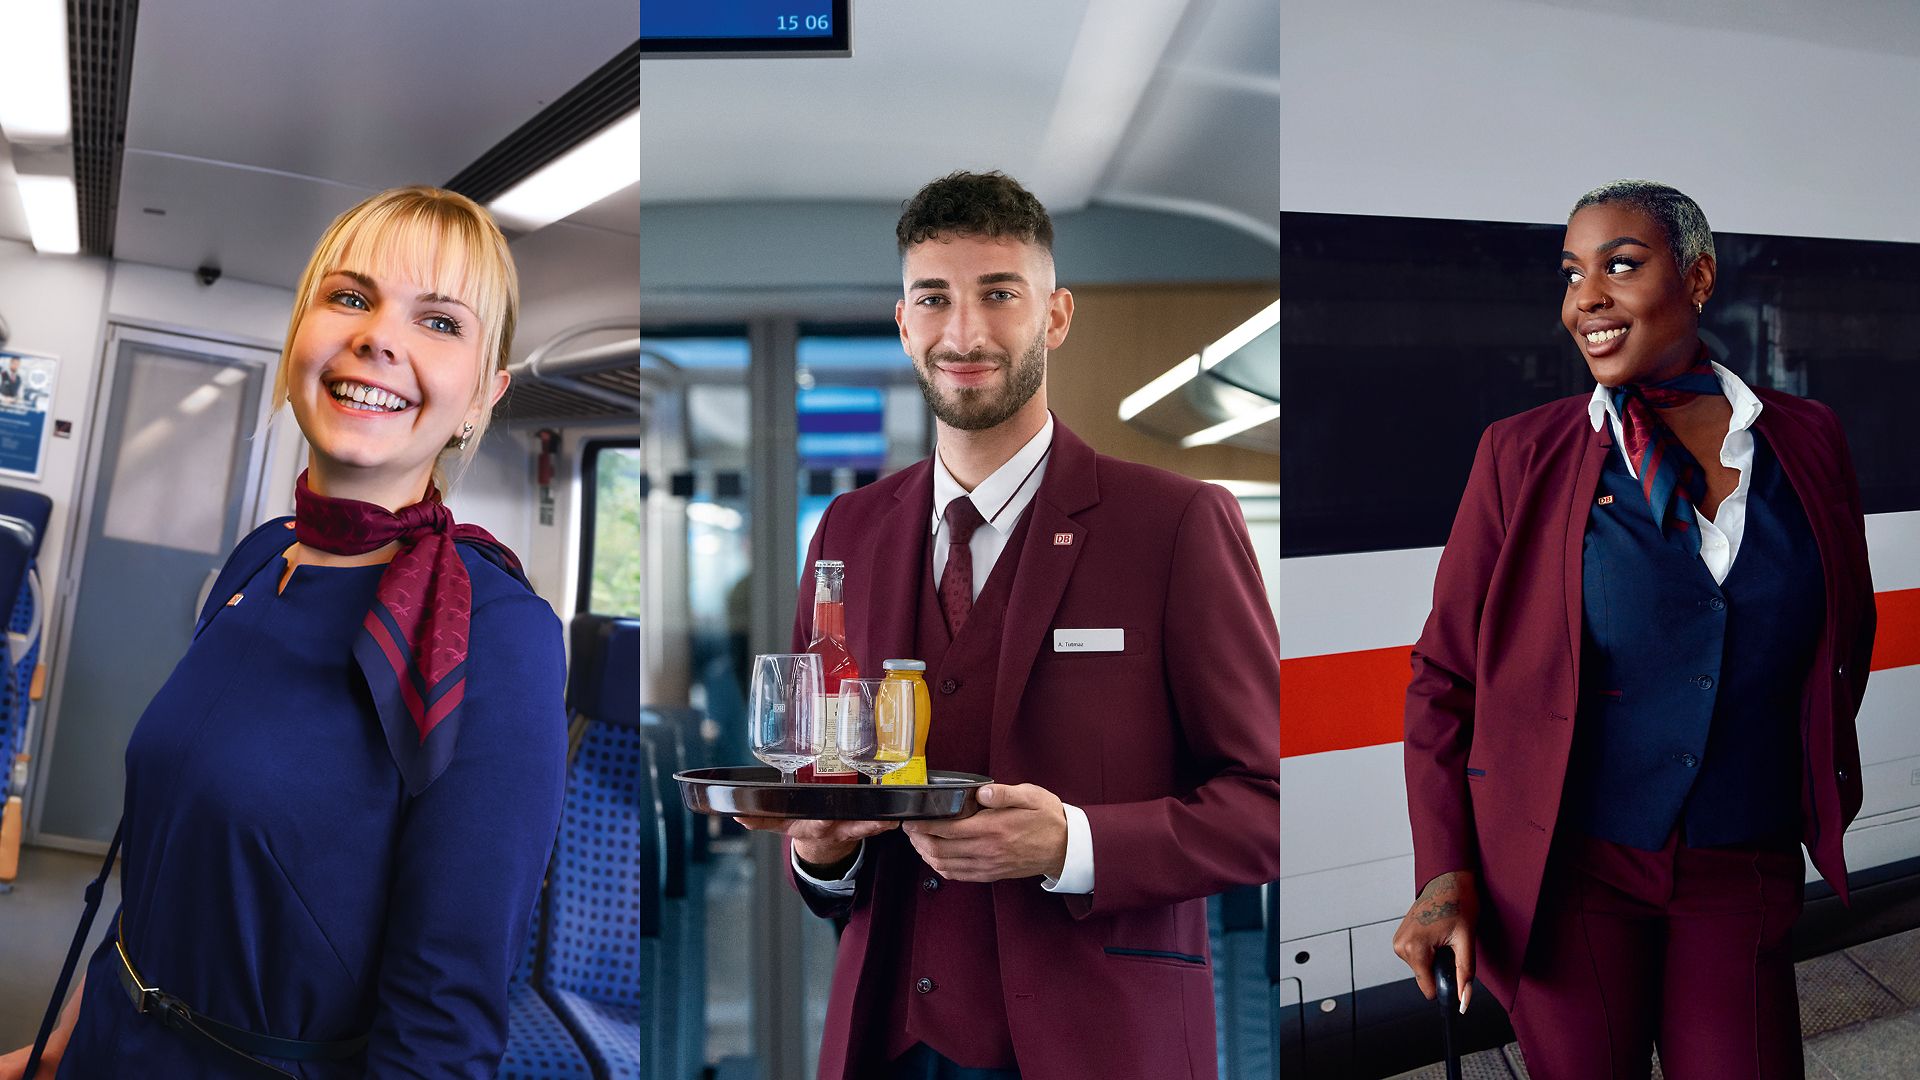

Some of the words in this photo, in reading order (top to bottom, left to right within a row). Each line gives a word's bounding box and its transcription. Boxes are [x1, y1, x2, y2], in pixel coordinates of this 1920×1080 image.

[777, 15, 799, 31] 15
[805, 14, 829, 30] 06
[1056, 535, 1071, 543] DB
